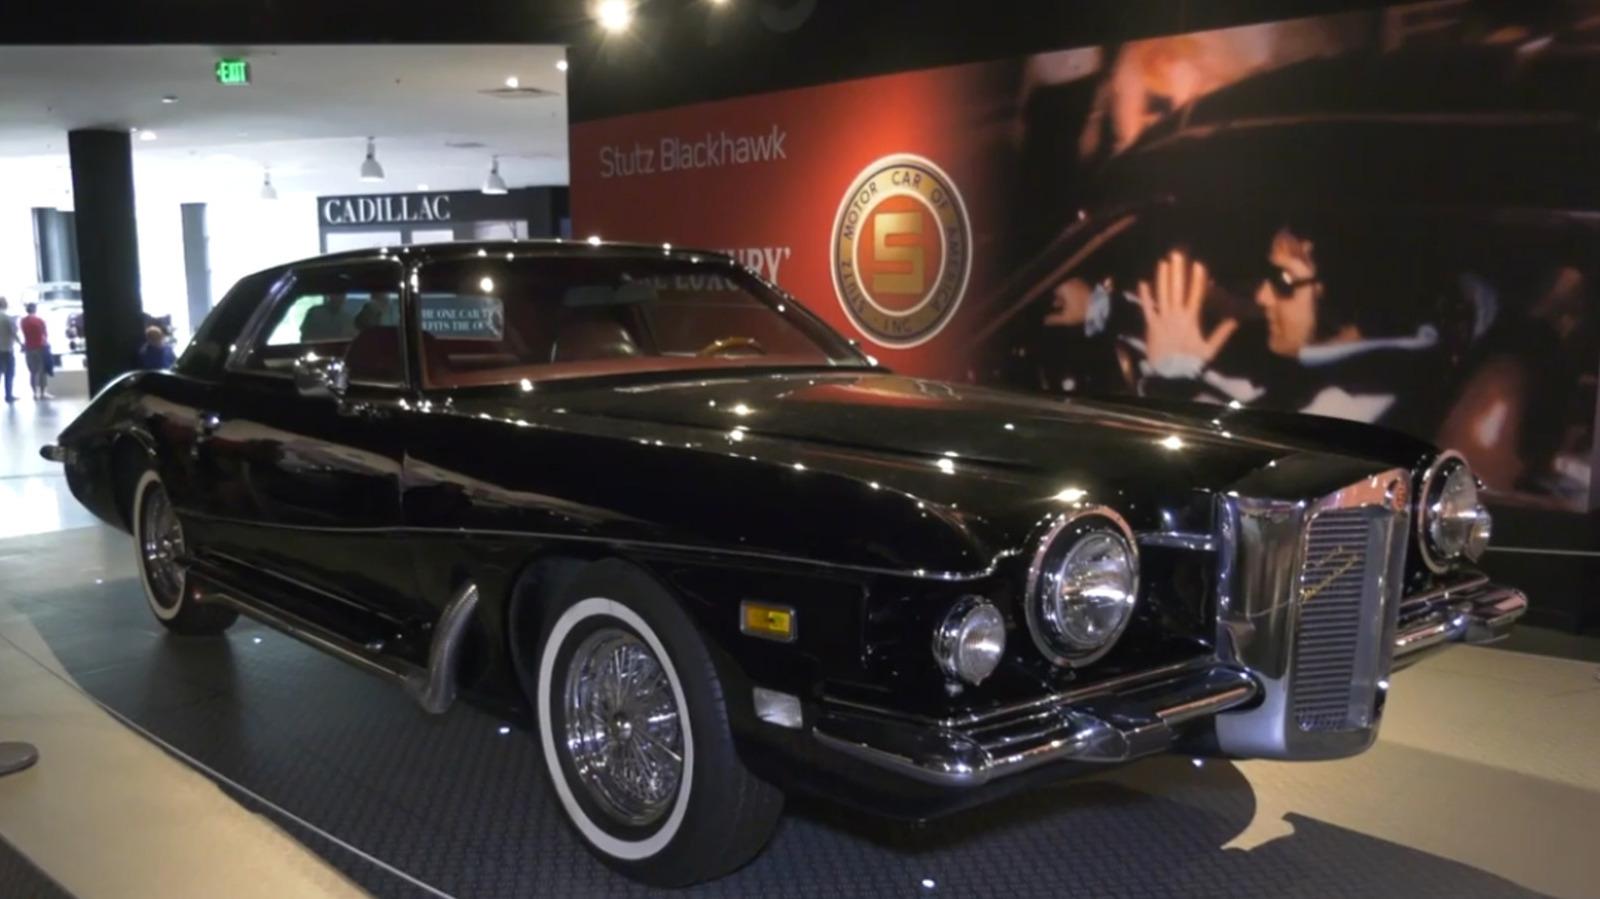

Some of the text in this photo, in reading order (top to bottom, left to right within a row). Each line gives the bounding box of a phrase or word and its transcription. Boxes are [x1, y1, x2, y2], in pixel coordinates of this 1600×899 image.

[221, 62, 246, 82] EXIT
[600, 124, 787, 178] Stutz Blackhawk
[891, 171, 922, 190] CAR
[324, 195, 451, 224] CADILLAC
[843, 181, 878, 241] MOTOR
[930, 187, 952, 212] OF
[841, 260, 865, 314] STUTZ
